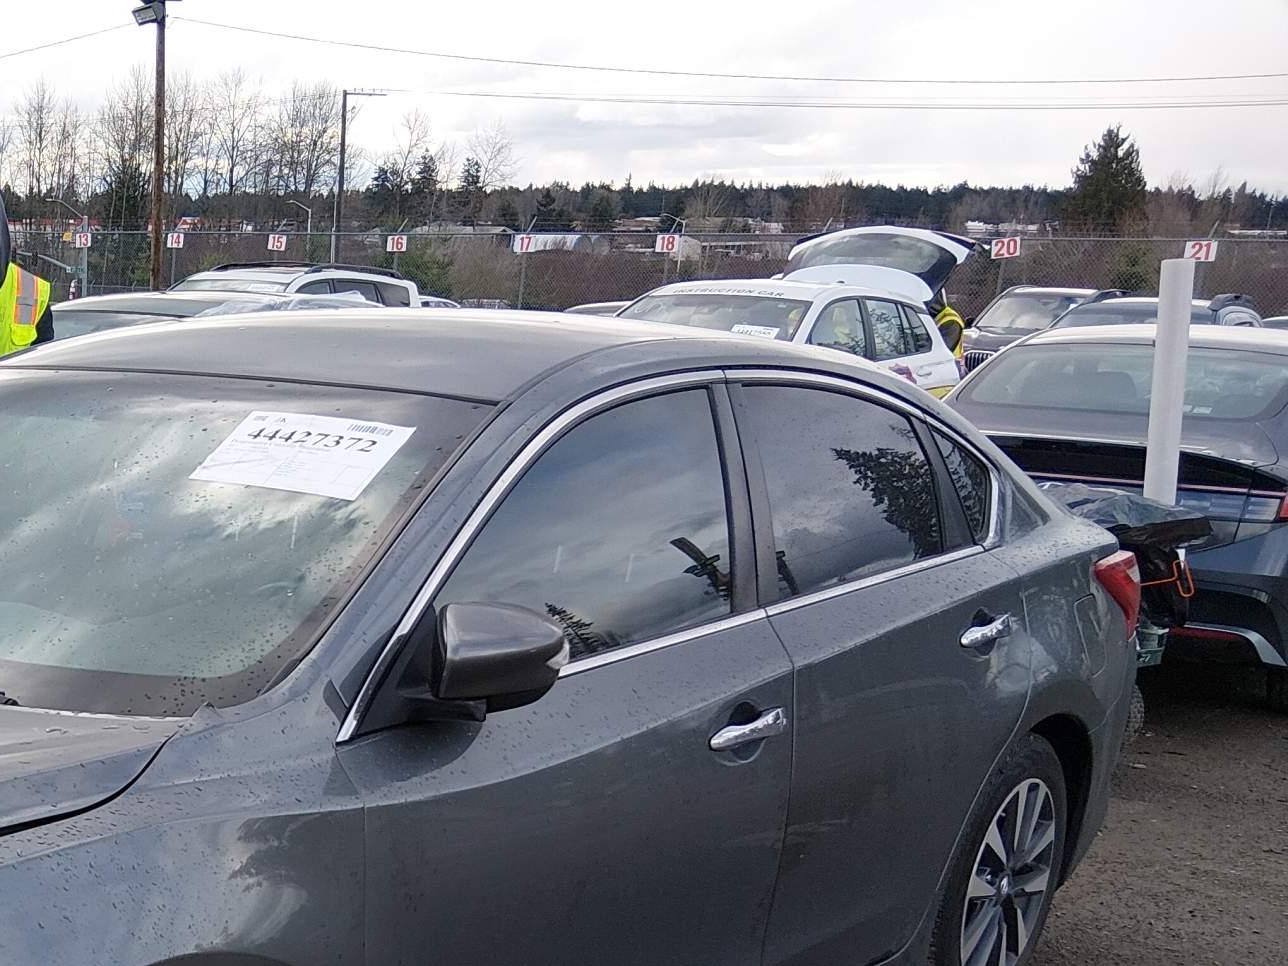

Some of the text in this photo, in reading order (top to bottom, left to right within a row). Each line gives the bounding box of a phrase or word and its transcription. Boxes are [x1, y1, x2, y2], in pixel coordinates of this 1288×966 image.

[78, 233, 89, 247] 13
[169, 233, 181, 247] 14
[271, 235, 283, 249] 15
[390, 236, 404, 250] 16
[519, 236, 532, 251] 17
[661, 236, 675, 251] 18
[994, 239, 1018, 257] 20
[1191, 242, 1212, 260] 21
[248, 427, 378, 453] 44427372
